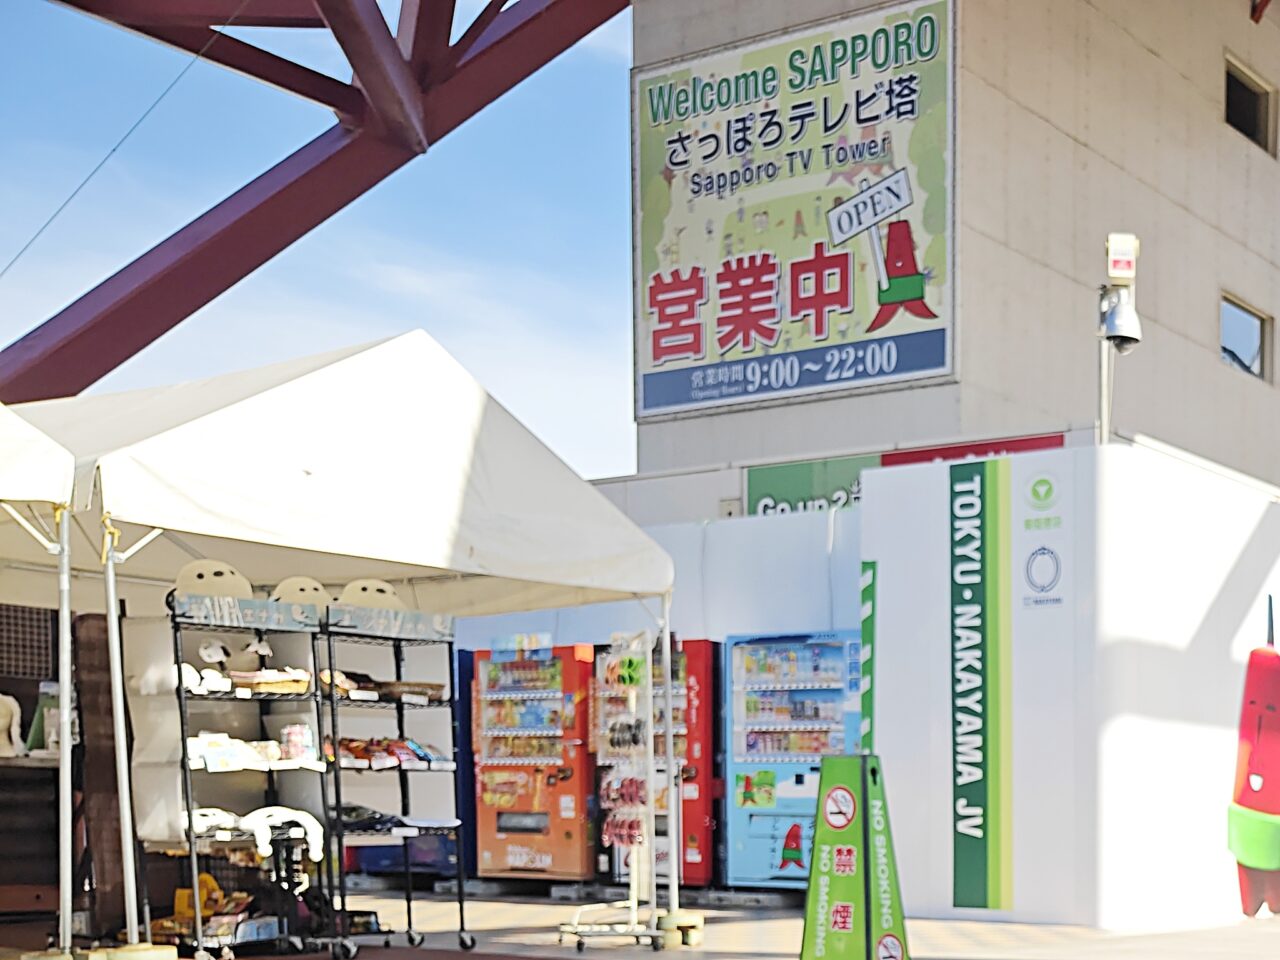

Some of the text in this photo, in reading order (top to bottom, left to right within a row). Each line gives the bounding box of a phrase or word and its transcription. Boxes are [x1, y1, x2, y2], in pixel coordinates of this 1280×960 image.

[649, 15, 938, 124] Welcome SAPPORO
[667, 74, 918, 167] さっぽろテレビ塔
[690, 135, 890, 199] Sapporo TV Tower
[837, 180, 901, 235] OPEN
[648, 240, 852, 364] 営業中
[872, 802, 893, 928] NO SMOKING
[955, 797, 984, 839] JV
[816, 846, 831, 956] NO SMOKING
